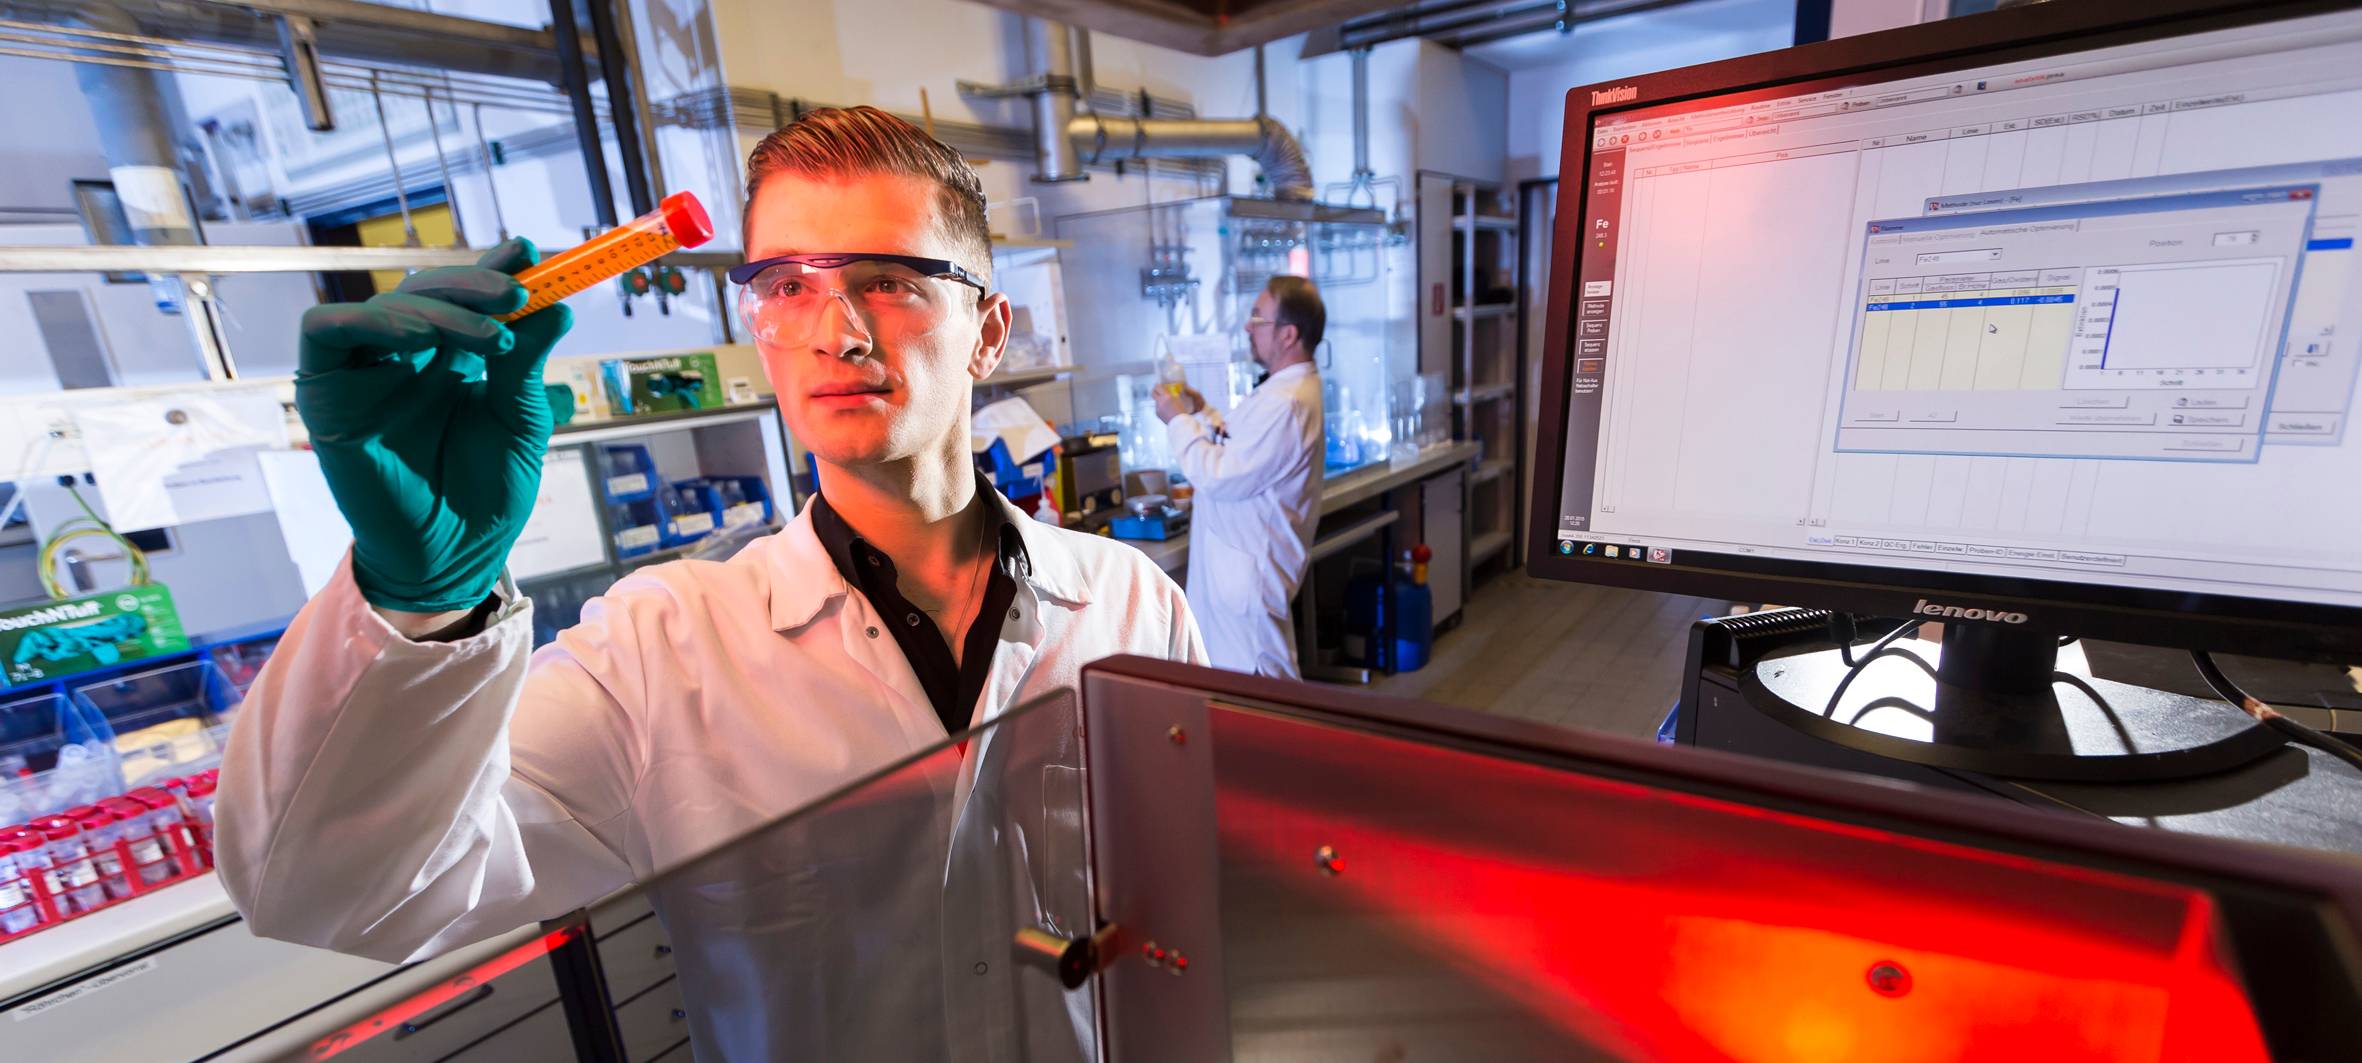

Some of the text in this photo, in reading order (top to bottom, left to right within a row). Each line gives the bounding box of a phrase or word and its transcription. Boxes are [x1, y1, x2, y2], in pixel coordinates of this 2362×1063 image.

[1591, 85, 1638, 106] ThinkVision
[1905, 133, 1928, 143] Name
[1596, 219, 1609, 230] Fe
[620, 243, 630, 253] 11
[633, 237, 644, 248] 12
[608, 249, 618, 259] 10
[0, 600, 101, 632] ouchNTuff
[1912, 599, 2029, 625] lenovo
